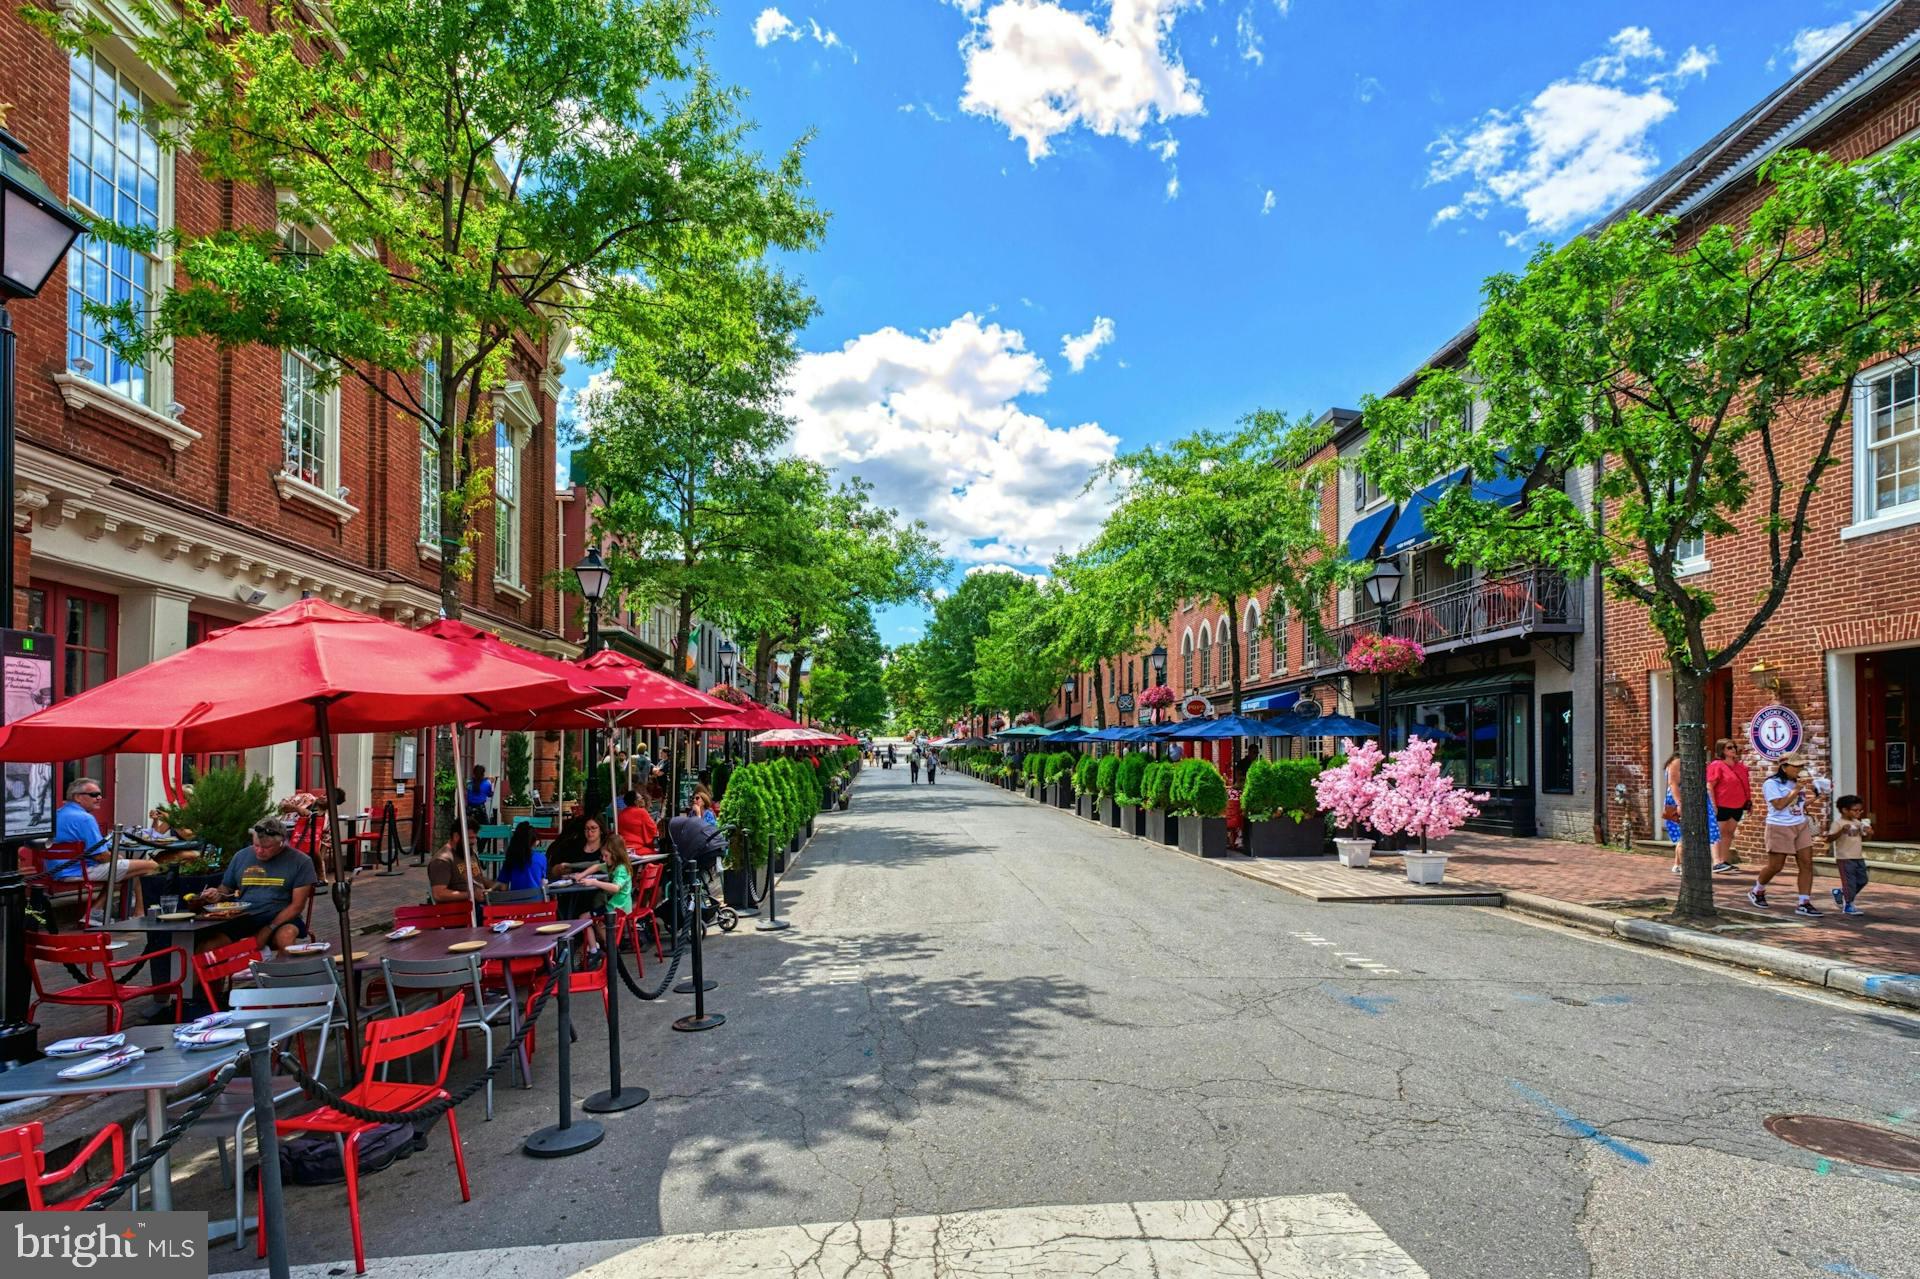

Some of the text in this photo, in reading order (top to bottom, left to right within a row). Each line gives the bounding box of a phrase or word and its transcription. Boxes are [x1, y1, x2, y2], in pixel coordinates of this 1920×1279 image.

[1754, 709, 1797, 728] THE LUCKY KNOT
